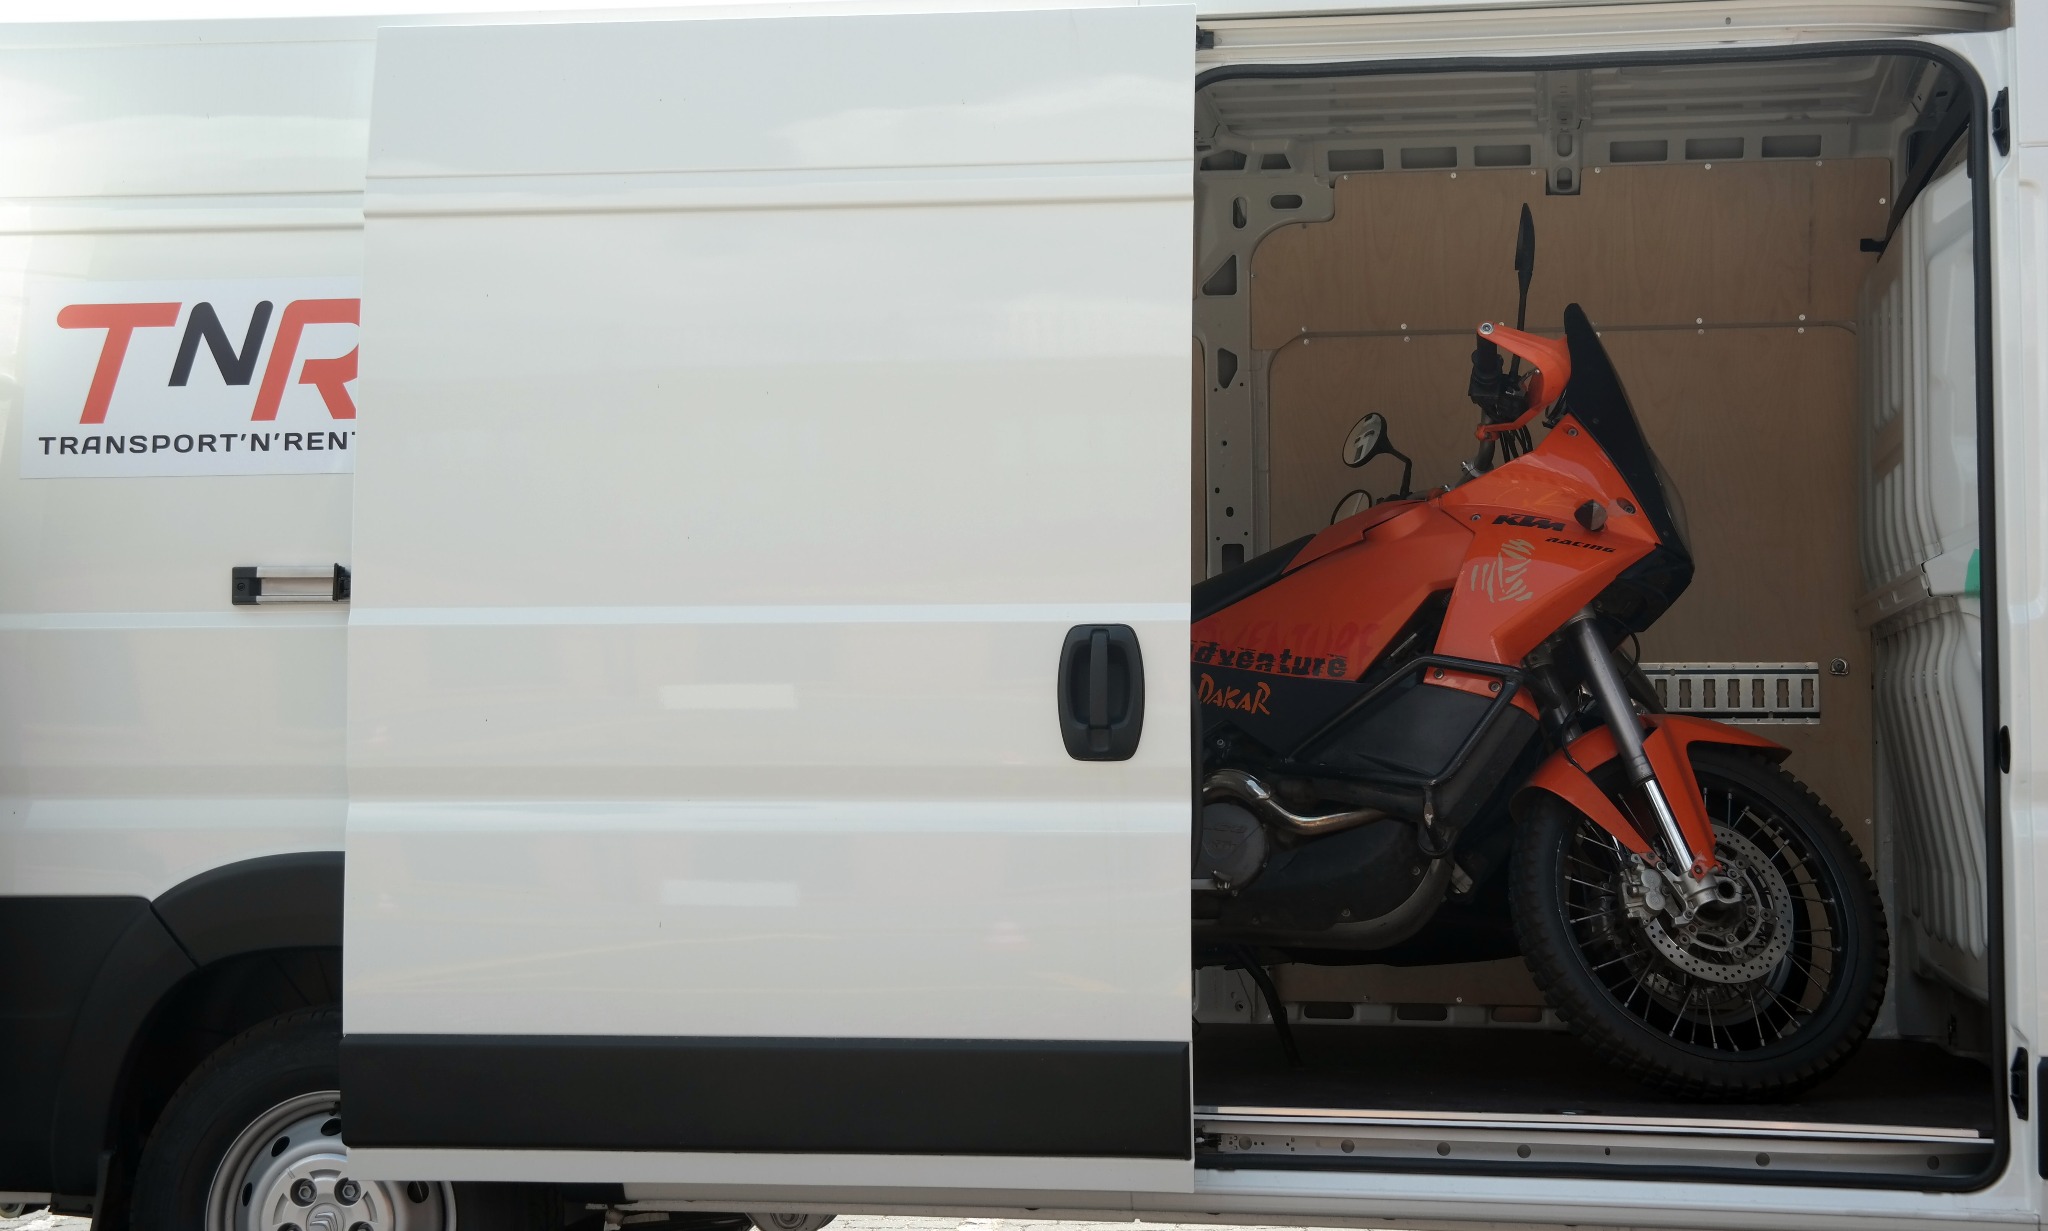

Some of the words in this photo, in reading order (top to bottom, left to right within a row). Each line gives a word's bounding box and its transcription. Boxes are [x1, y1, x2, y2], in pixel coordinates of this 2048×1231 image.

[57, 298, 360, 424] TNR
[38, 431, 356, 455] TRANSPORT'N'REN
[1492, 513, 1566, 532] KTM
